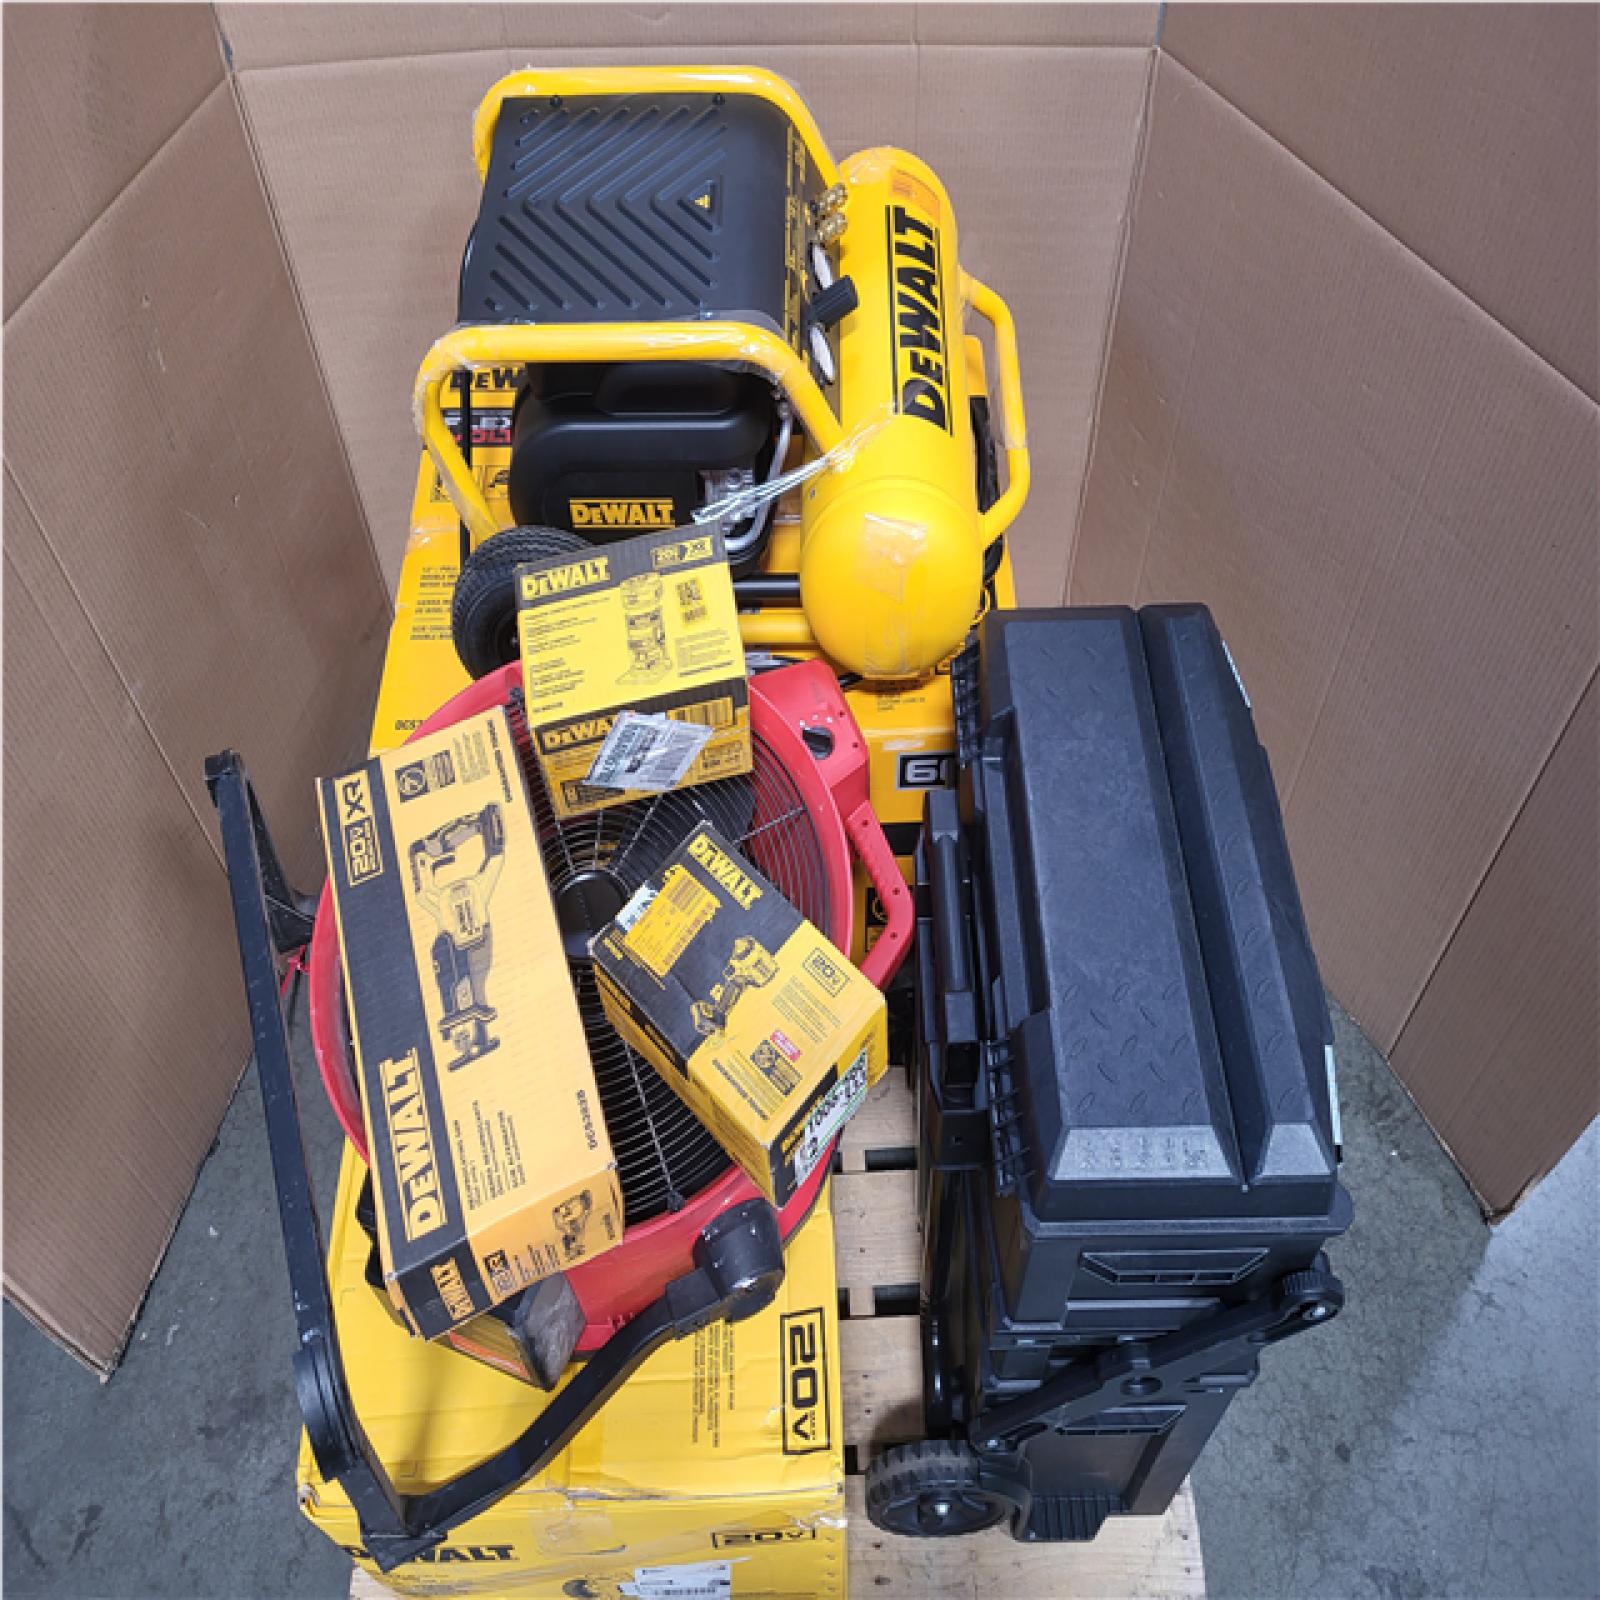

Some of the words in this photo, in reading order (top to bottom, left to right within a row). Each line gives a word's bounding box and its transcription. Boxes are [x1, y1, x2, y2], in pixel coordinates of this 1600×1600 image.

[894, 206, 947, 431] DEWALT
[450, 367, 526, 388] DEW
[571, 504, 673, 524] DEWALT
[521, 556, 611, 600] DEWALT
[544, 713, 618, 750] DEWA
[342, 779, 366, 820] XR
[688, 833, 764, 911] DEWALT
[379, 1046, 447, 1242] DEWALT
[790, 1322, 818, 1441] 20V
